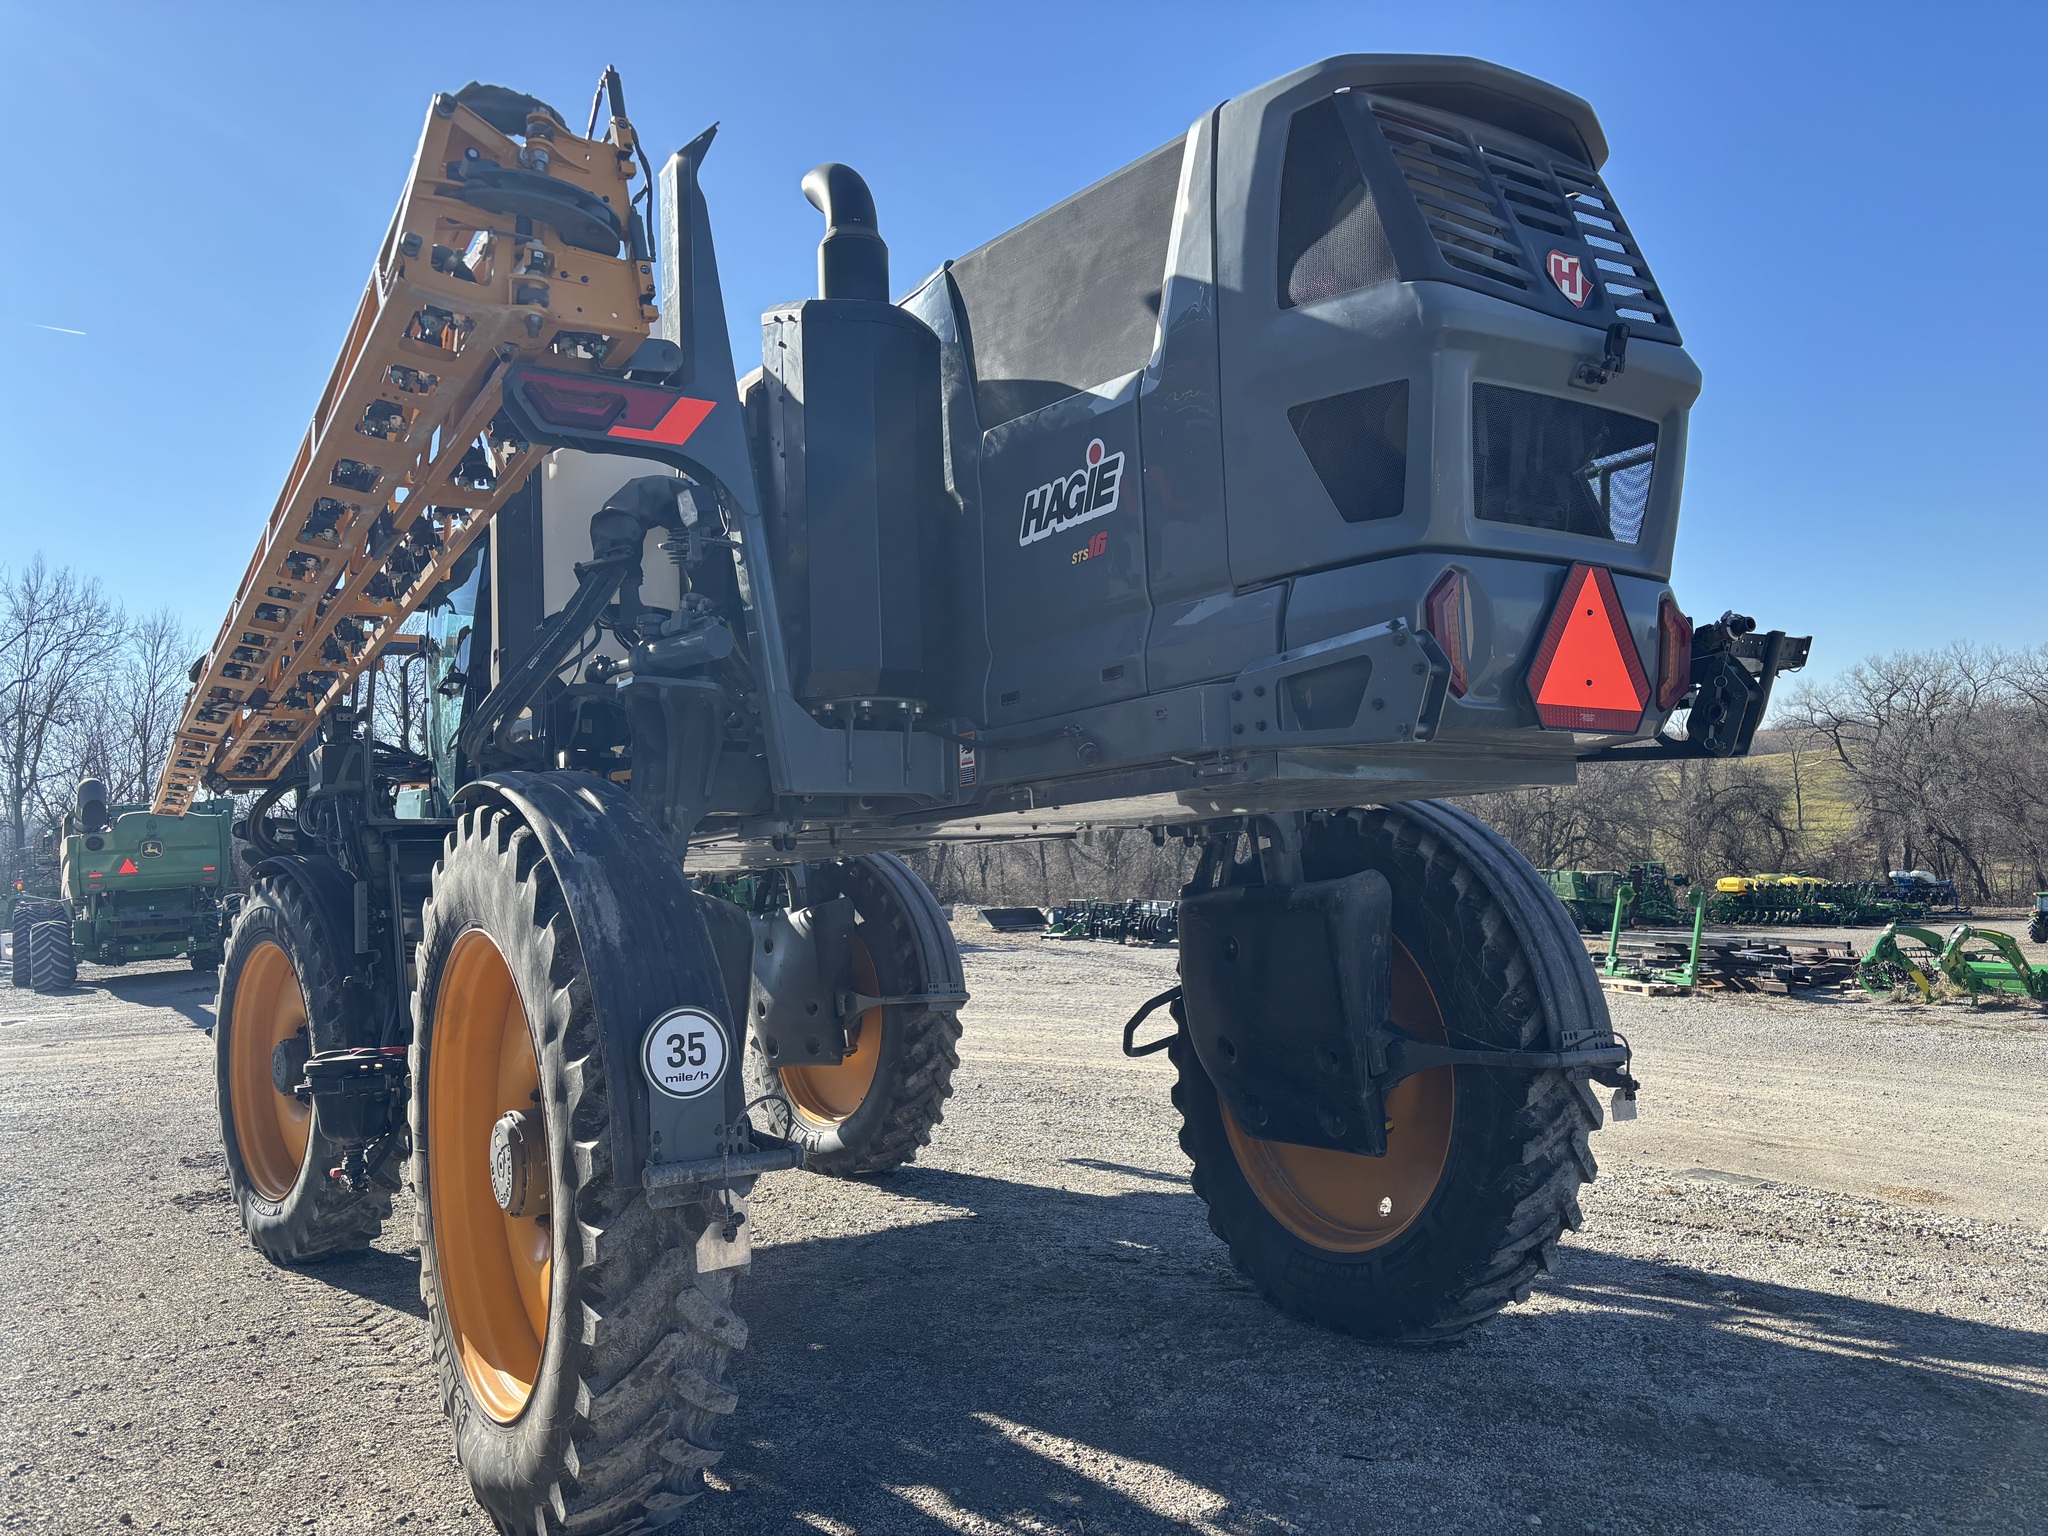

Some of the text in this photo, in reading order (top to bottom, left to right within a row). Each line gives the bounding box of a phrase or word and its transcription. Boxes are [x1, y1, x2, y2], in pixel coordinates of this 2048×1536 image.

[1019, 438, 1125, 546] HAGIE
[1071, 531, 1108, 565] STS16
[667, 1032, 706, 1068] 35
[665, 1071, 709, 1083] mile/h
